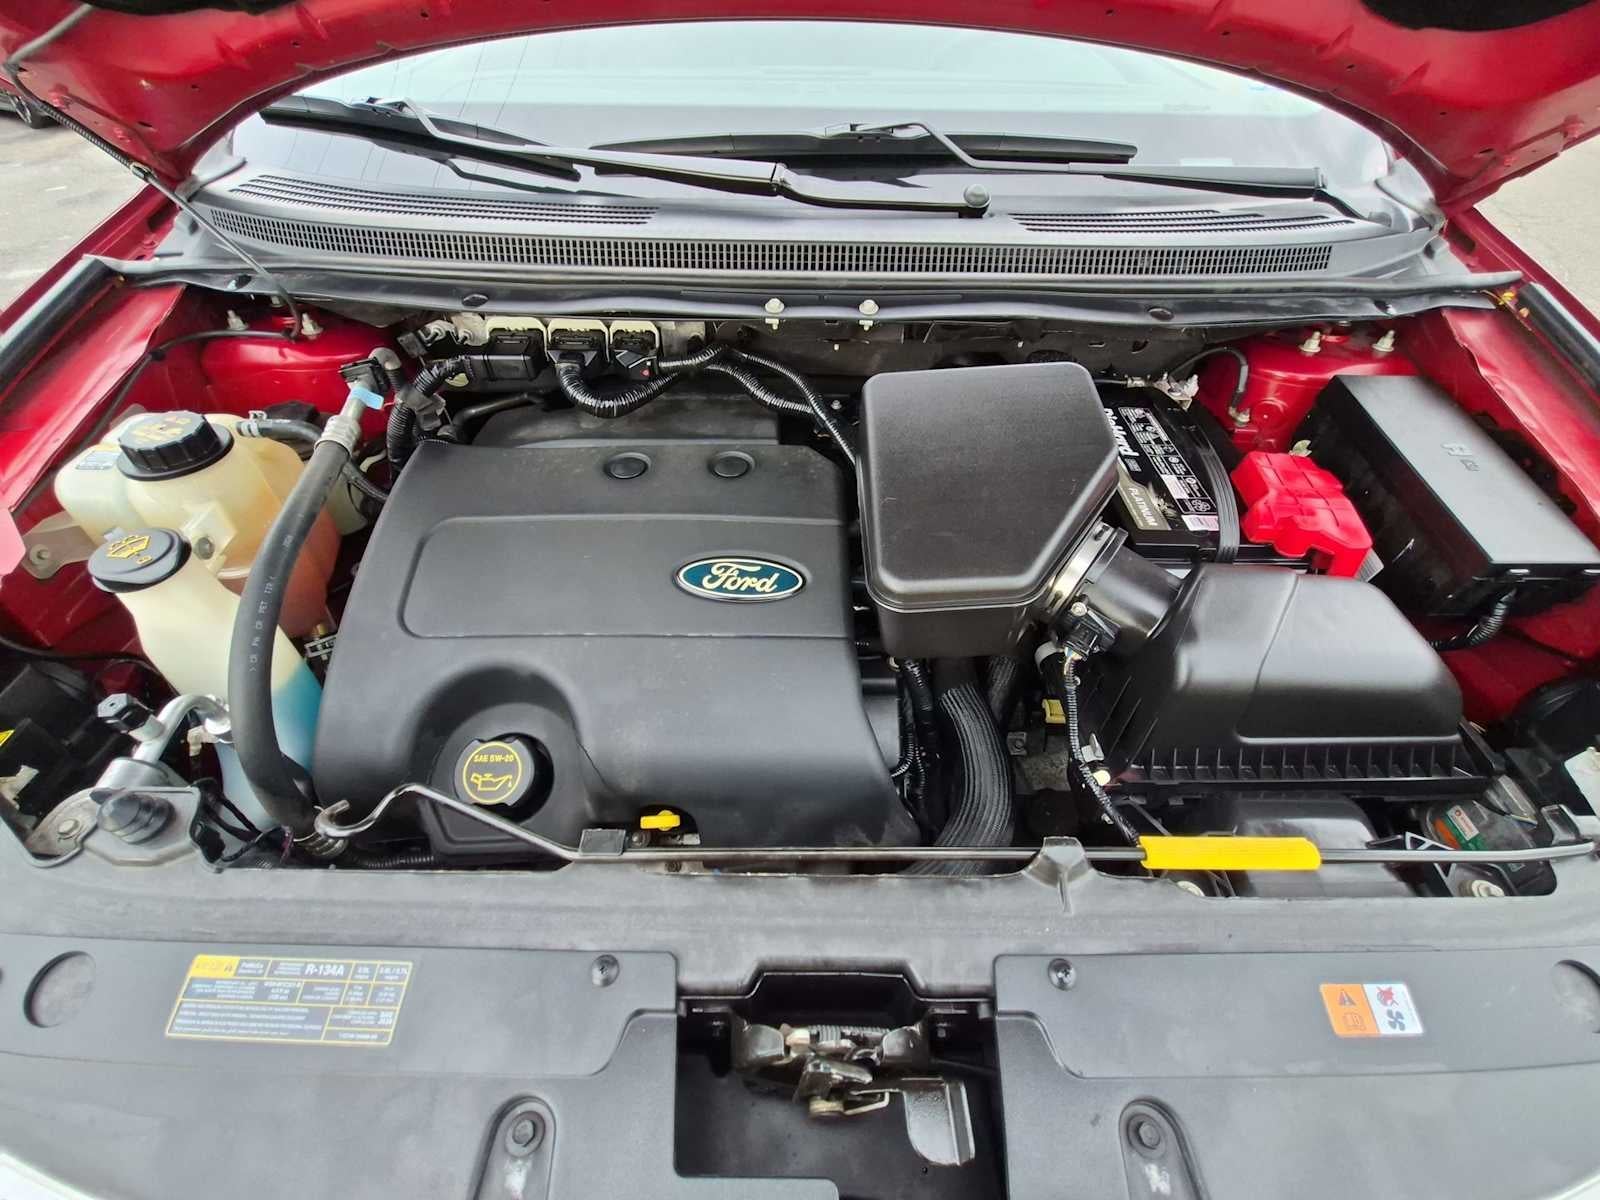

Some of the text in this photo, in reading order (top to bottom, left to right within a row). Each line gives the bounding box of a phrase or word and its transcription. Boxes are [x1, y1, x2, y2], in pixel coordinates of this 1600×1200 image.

[702, 562, 780, 592] Ford
[474, 754, 489, 762] SAE
[305, 964, 345, 977] R-134A
